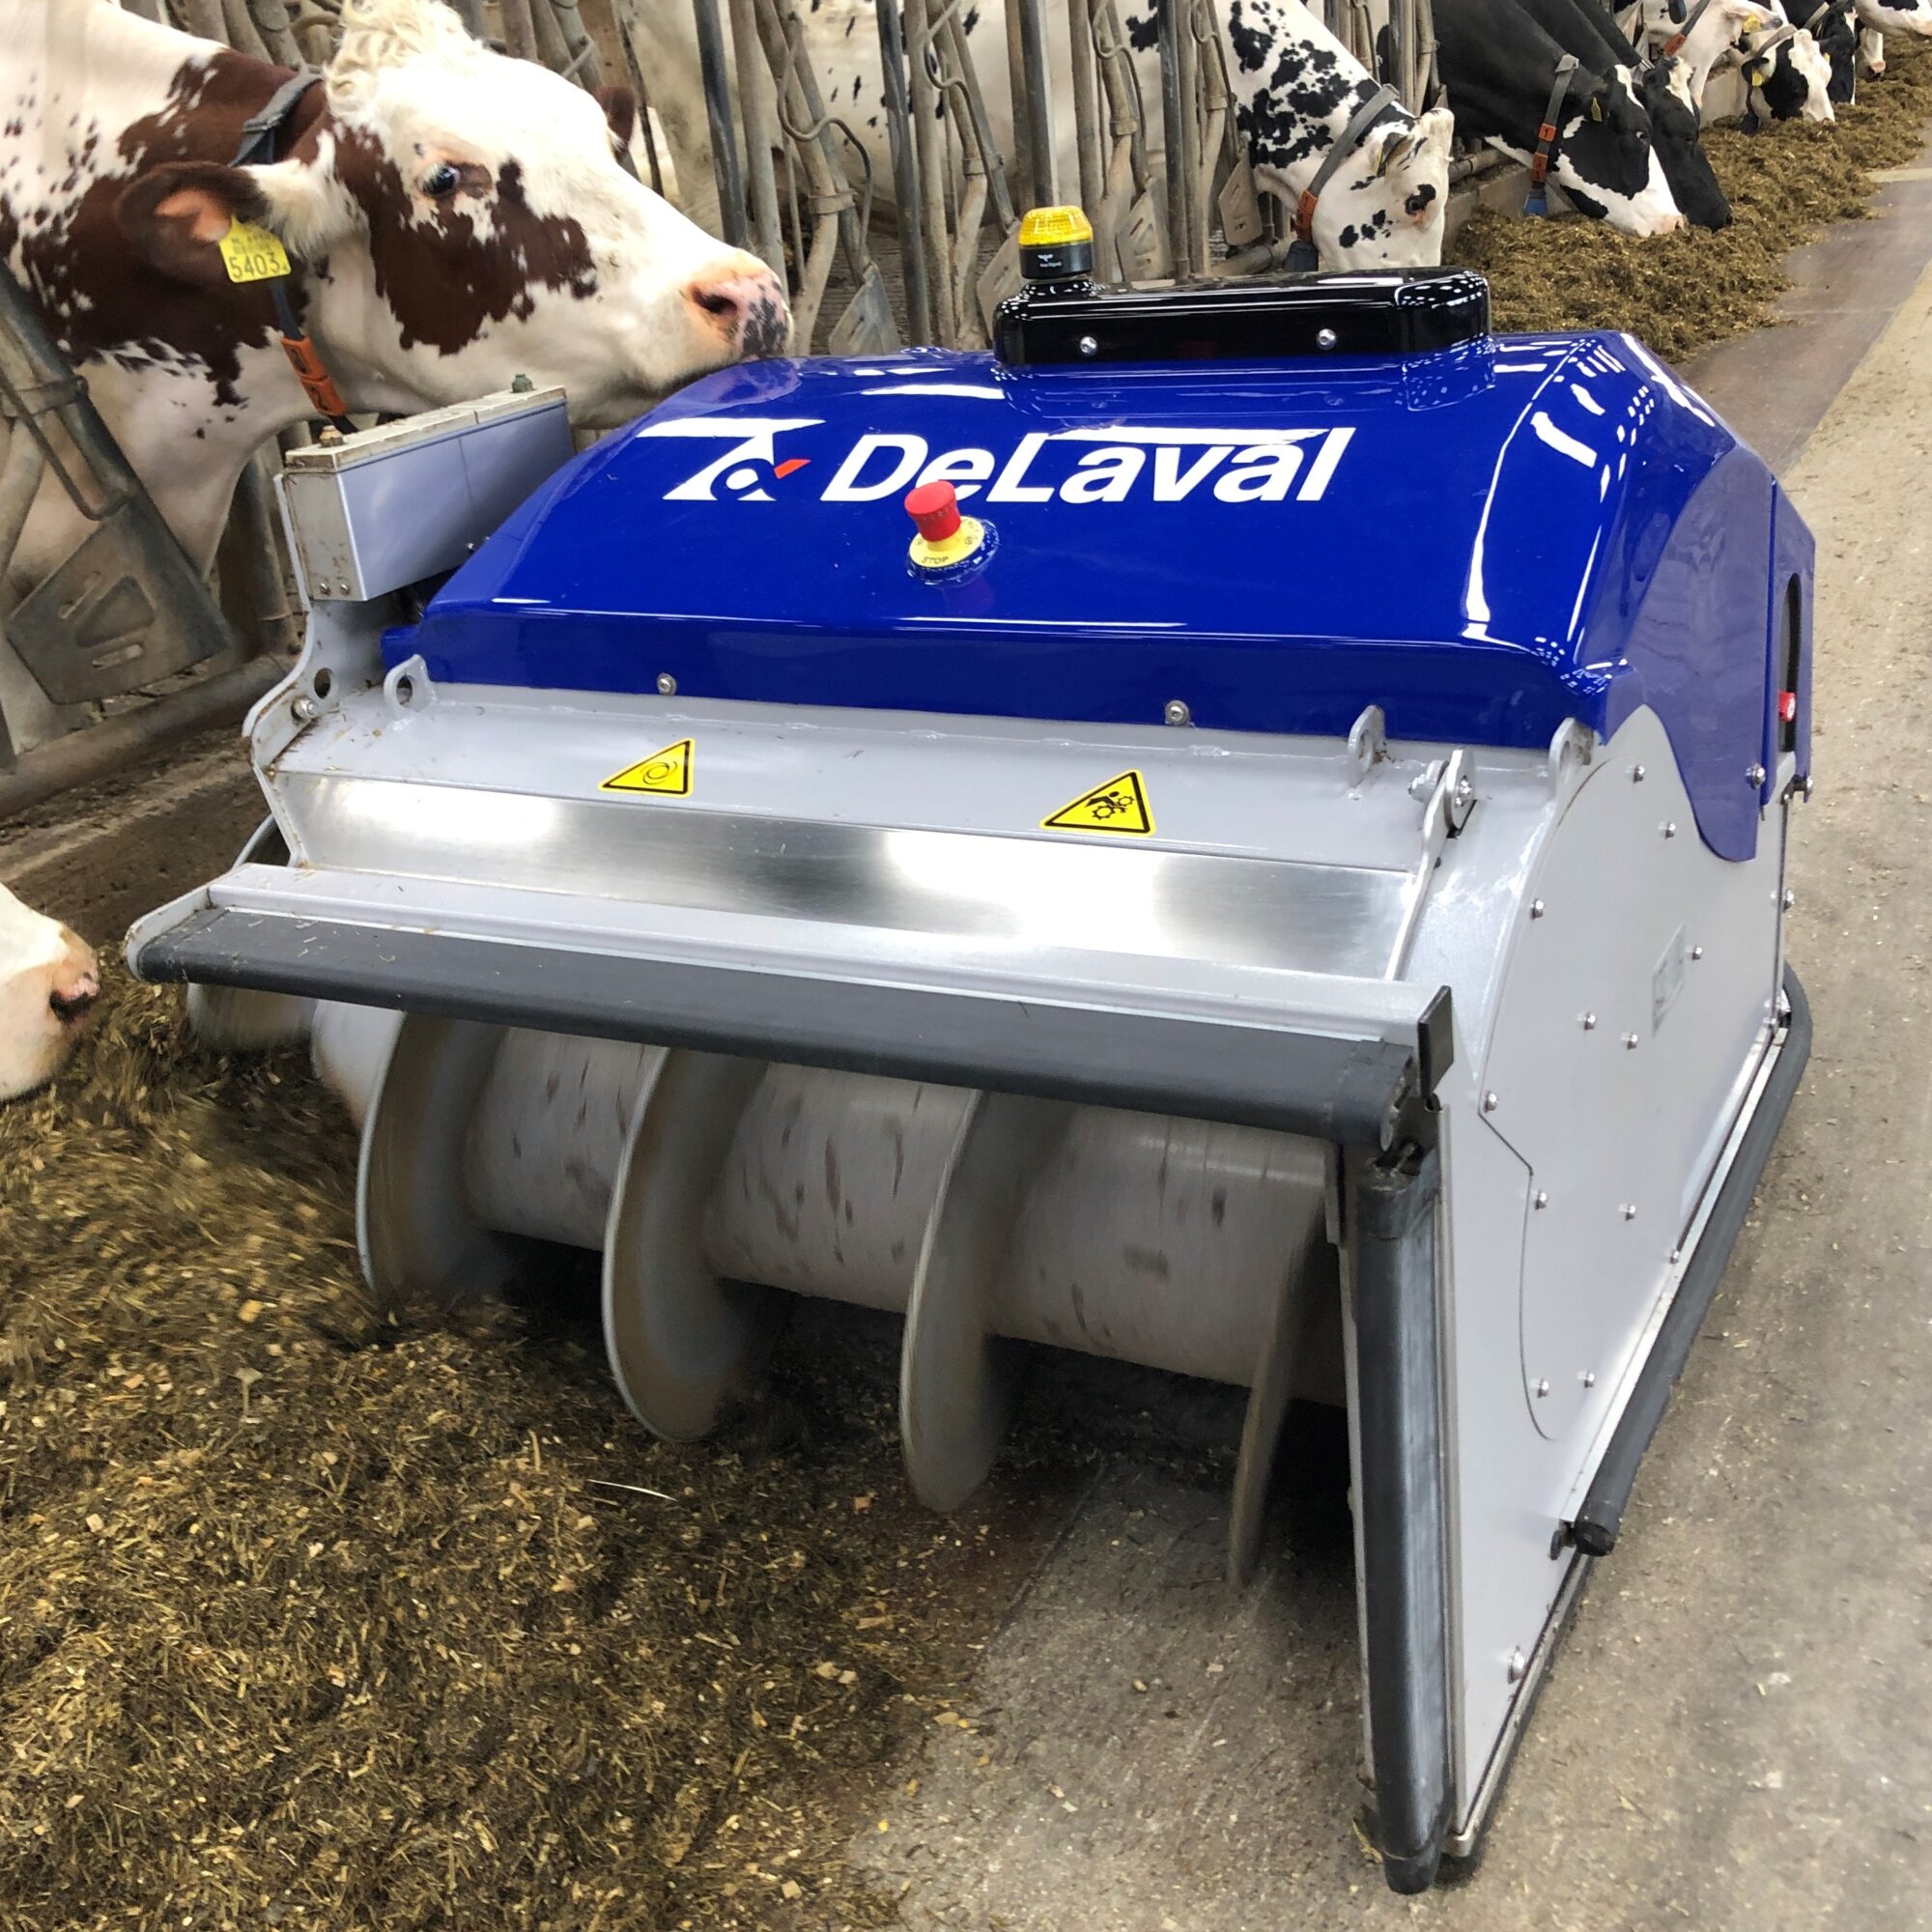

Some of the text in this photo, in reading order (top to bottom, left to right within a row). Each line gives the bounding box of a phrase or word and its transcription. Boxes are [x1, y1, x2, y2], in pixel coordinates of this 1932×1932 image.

[228, 252, 280, 280] 5403
[819, 428, 1356, 504] DeLaval
[921, 555, 950, 565] STOP
